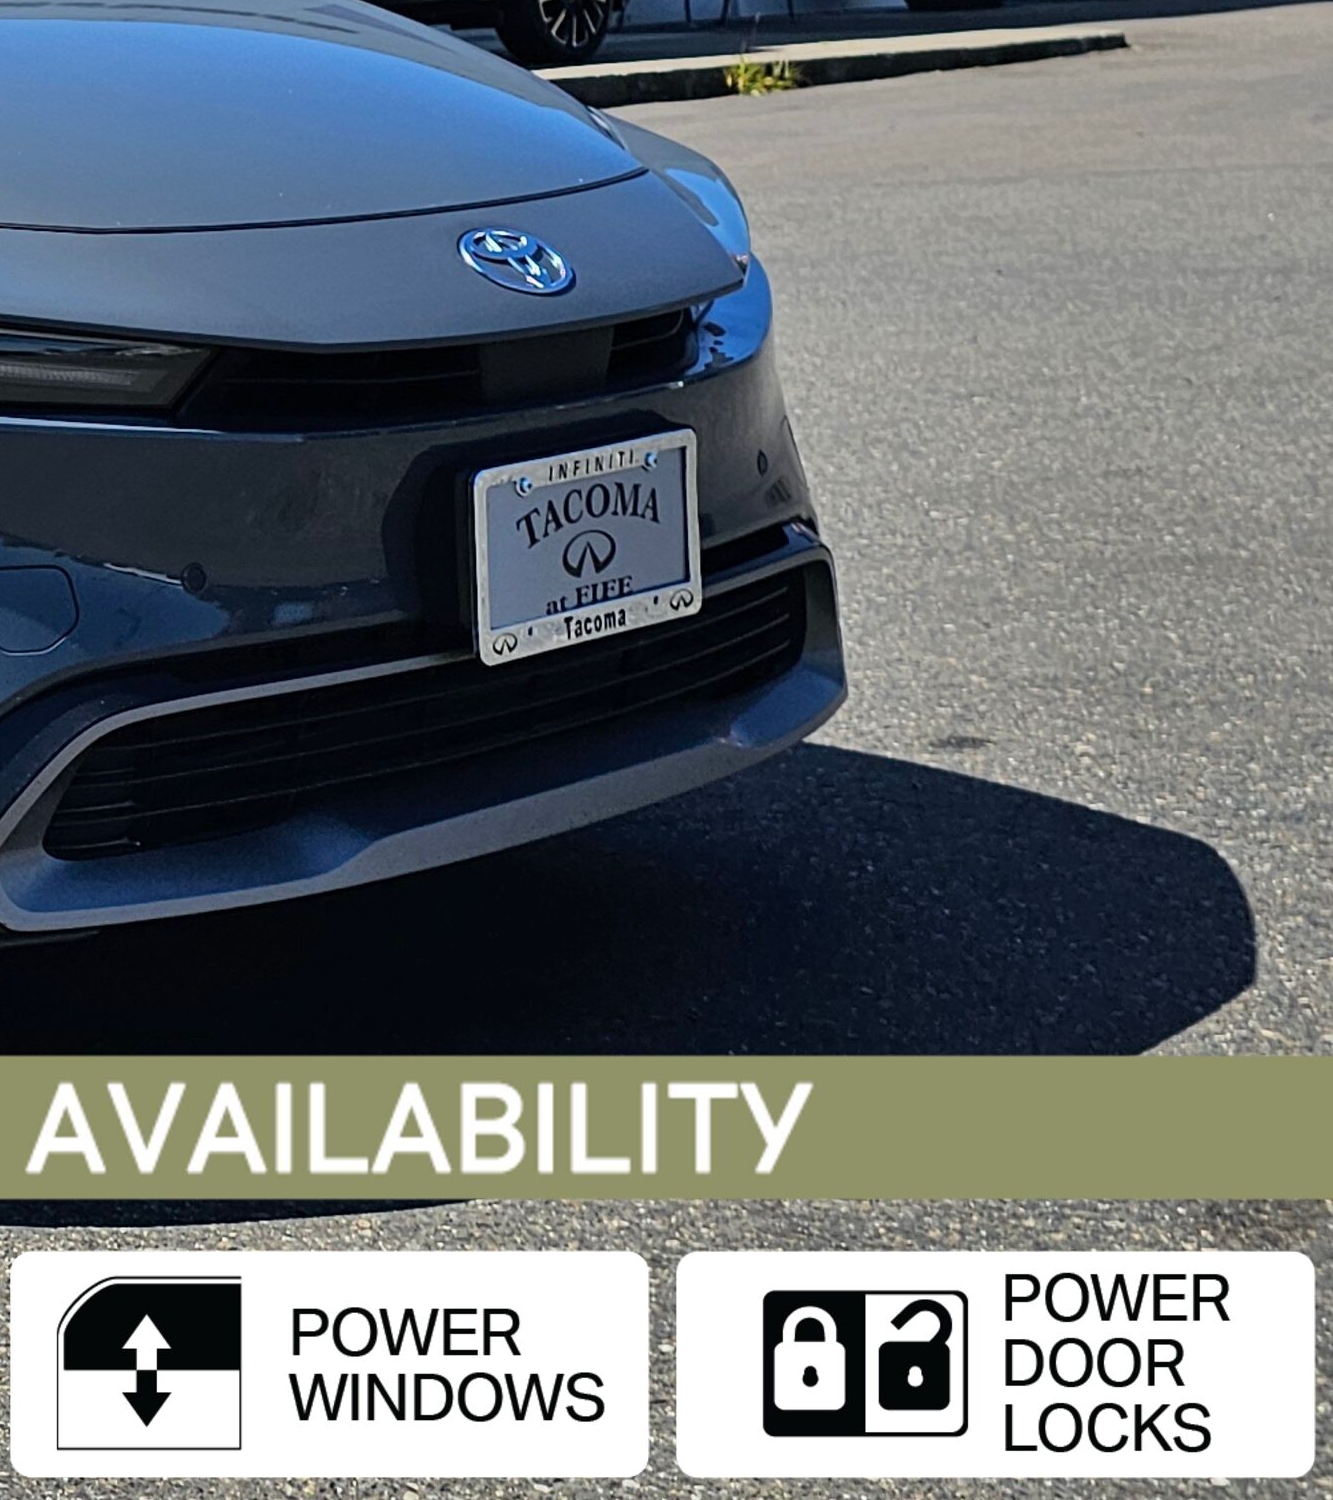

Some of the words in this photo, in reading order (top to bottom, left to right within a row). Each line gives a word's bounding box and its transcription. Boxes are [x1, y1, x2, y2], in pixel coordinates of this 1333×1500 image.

[549, 449, 634, 482] INFINITI
[516, 482, 660, 549] TACOMA
[546, 594, 567, 616] at
[575, 575, 633, 606] FIFE
[564, 608, 627, 640] Tacoma
